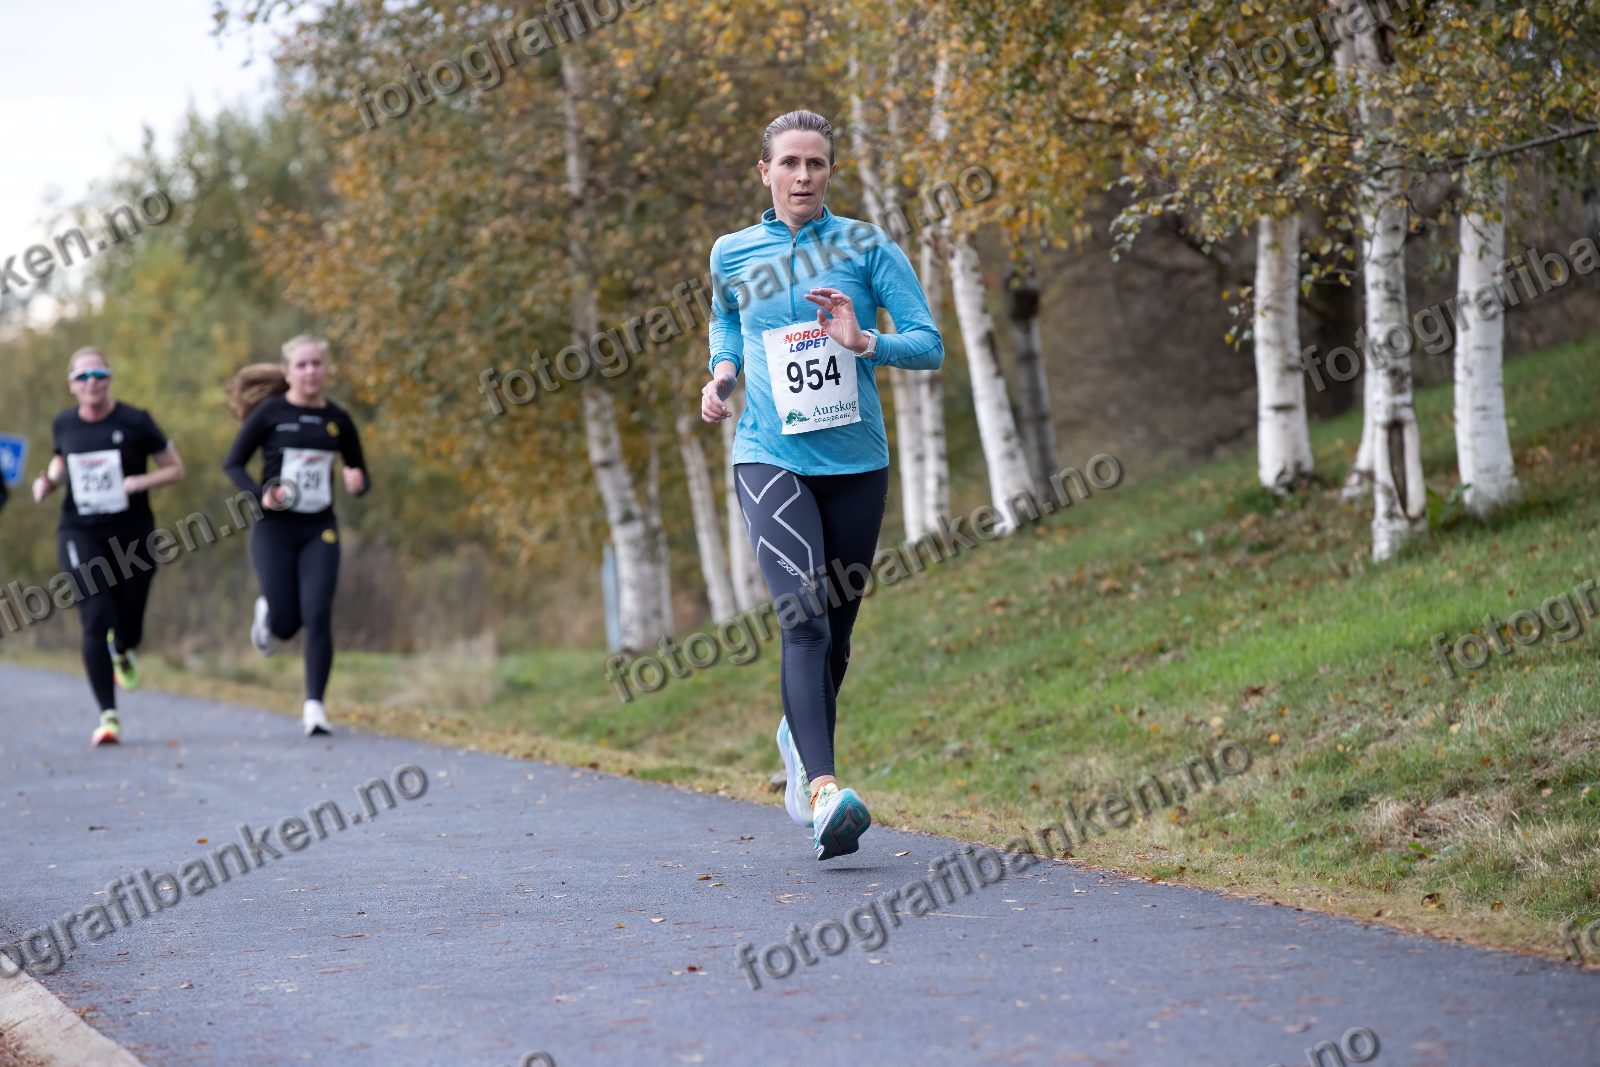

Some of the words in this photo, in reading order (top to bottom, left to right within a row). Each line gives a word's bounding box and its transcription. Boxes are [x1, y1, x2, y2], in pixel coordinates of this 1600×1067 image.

[785, 328, 827, 344] NORGE
[789, 336, 829, 353] LØPET
[786, 354, 841, 394] 954
[812, 400, 857, 417] Aurskog
[776, 558, 798, 576] 2XU
